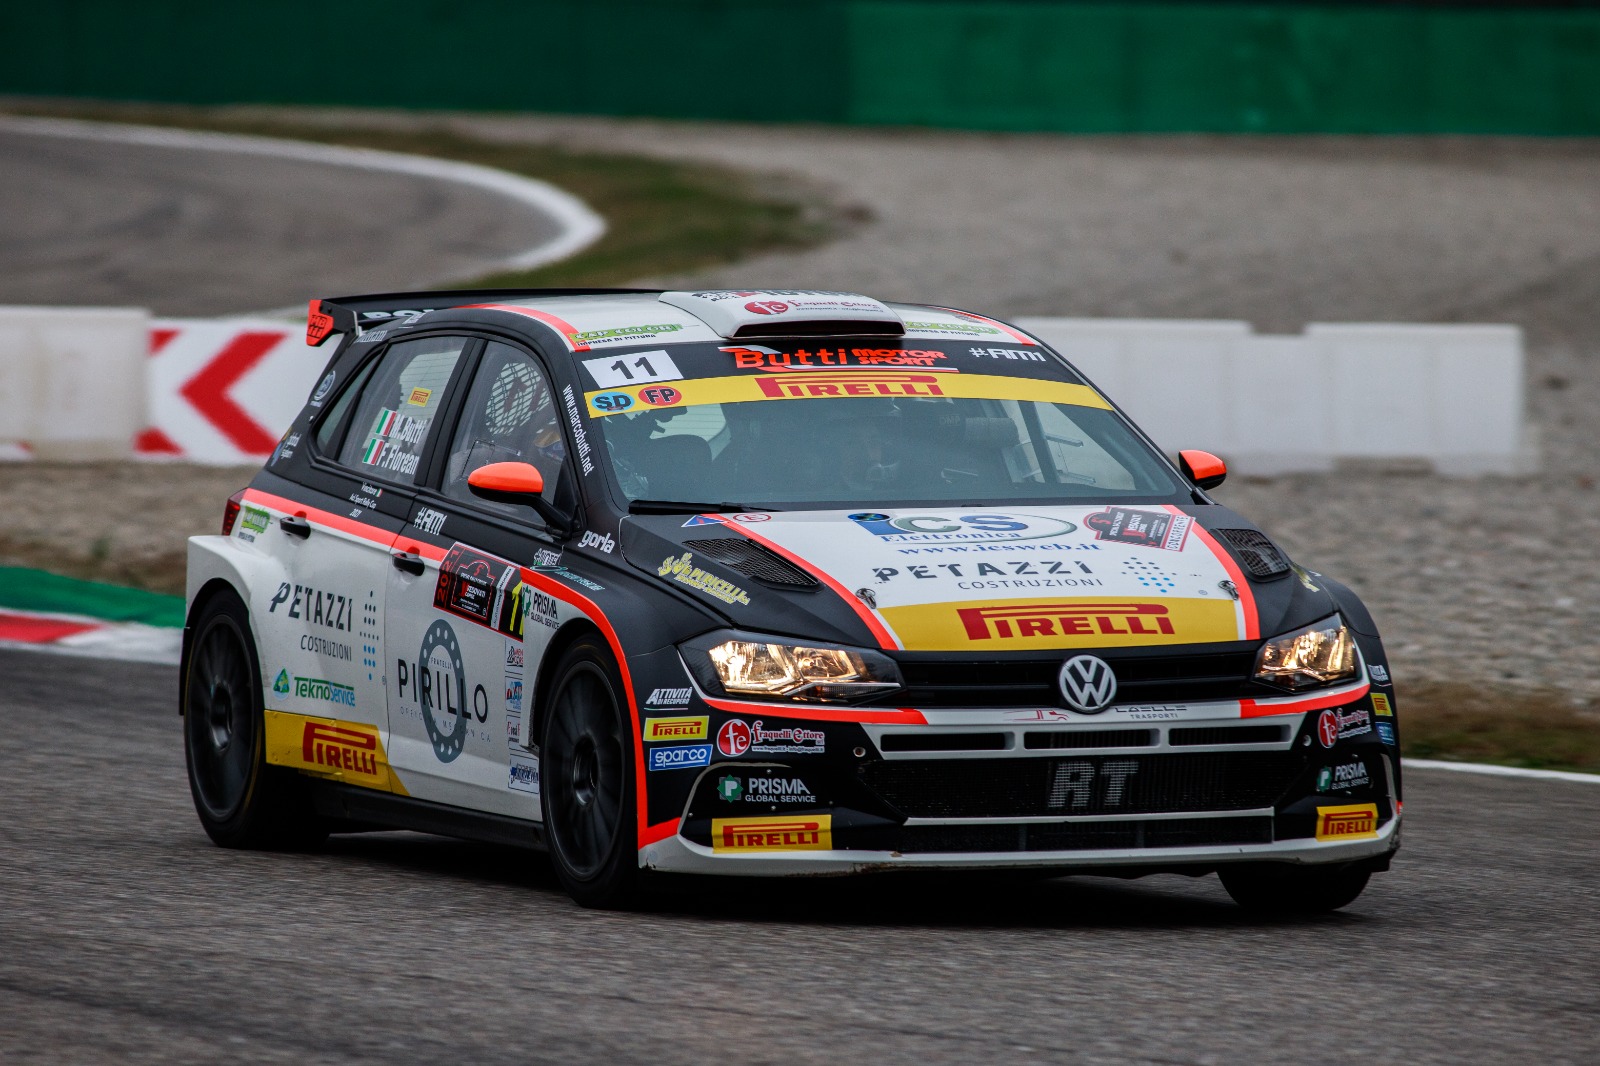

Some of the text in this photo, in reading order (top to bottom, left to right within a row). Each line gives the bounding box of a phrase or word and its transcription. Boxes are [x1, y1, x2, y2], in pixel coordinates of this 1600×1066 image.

[736, 348, 846, 369] Butti
[851, 348, 947, 359] MOTOR
[860, 357, 935, 366] SPORT
[610, 357, 658, 380] 11
[644, 387, 676, 403] FP
[755, 374, 944, 397] PIRELLI
[594, 394, 632, 409] SD
[388, 414, 427, 445] M.Butti
[563, 384, 594, 476] www.marcobutti.net
[376, 442, 420, 475] F.Florean
[578, 530, 615, 553] gorla
[882, 531, 1022, 543] Elettronica
[897, 543, 1103, 555] www.icsweb.it
[872, 561, 1093, 582] PETAZZI
[958, 578, 1104, 590] COSTRUZIONI
[269, 582, 353, 632] PETAZZI
[533, 592, 558, 619] PRISMA
[531, 612, 544, 625] GLOBAL
[957, 603, 1175, 640] PIRELLI
[300, 634, 352, 662] COSTRUZIONI
[398, 658, 488, 723] PIRILLO
[653, 721, 702, 737] PIRELLI
[302, 721, 377, 775] PIRELLI
[655, 748, 707, 768] sparco
[1334, 761, 1368, 782] PRISMA
[749, 777, 810, 795] PRISMA
[1048, 761, 1139, 808] RT
[745, 795, 816, 803] GLOBAL SERVICE
[1323, 811, 1373, 835] PIRELLI
[723, 822, 820, 847] PIRELLI
